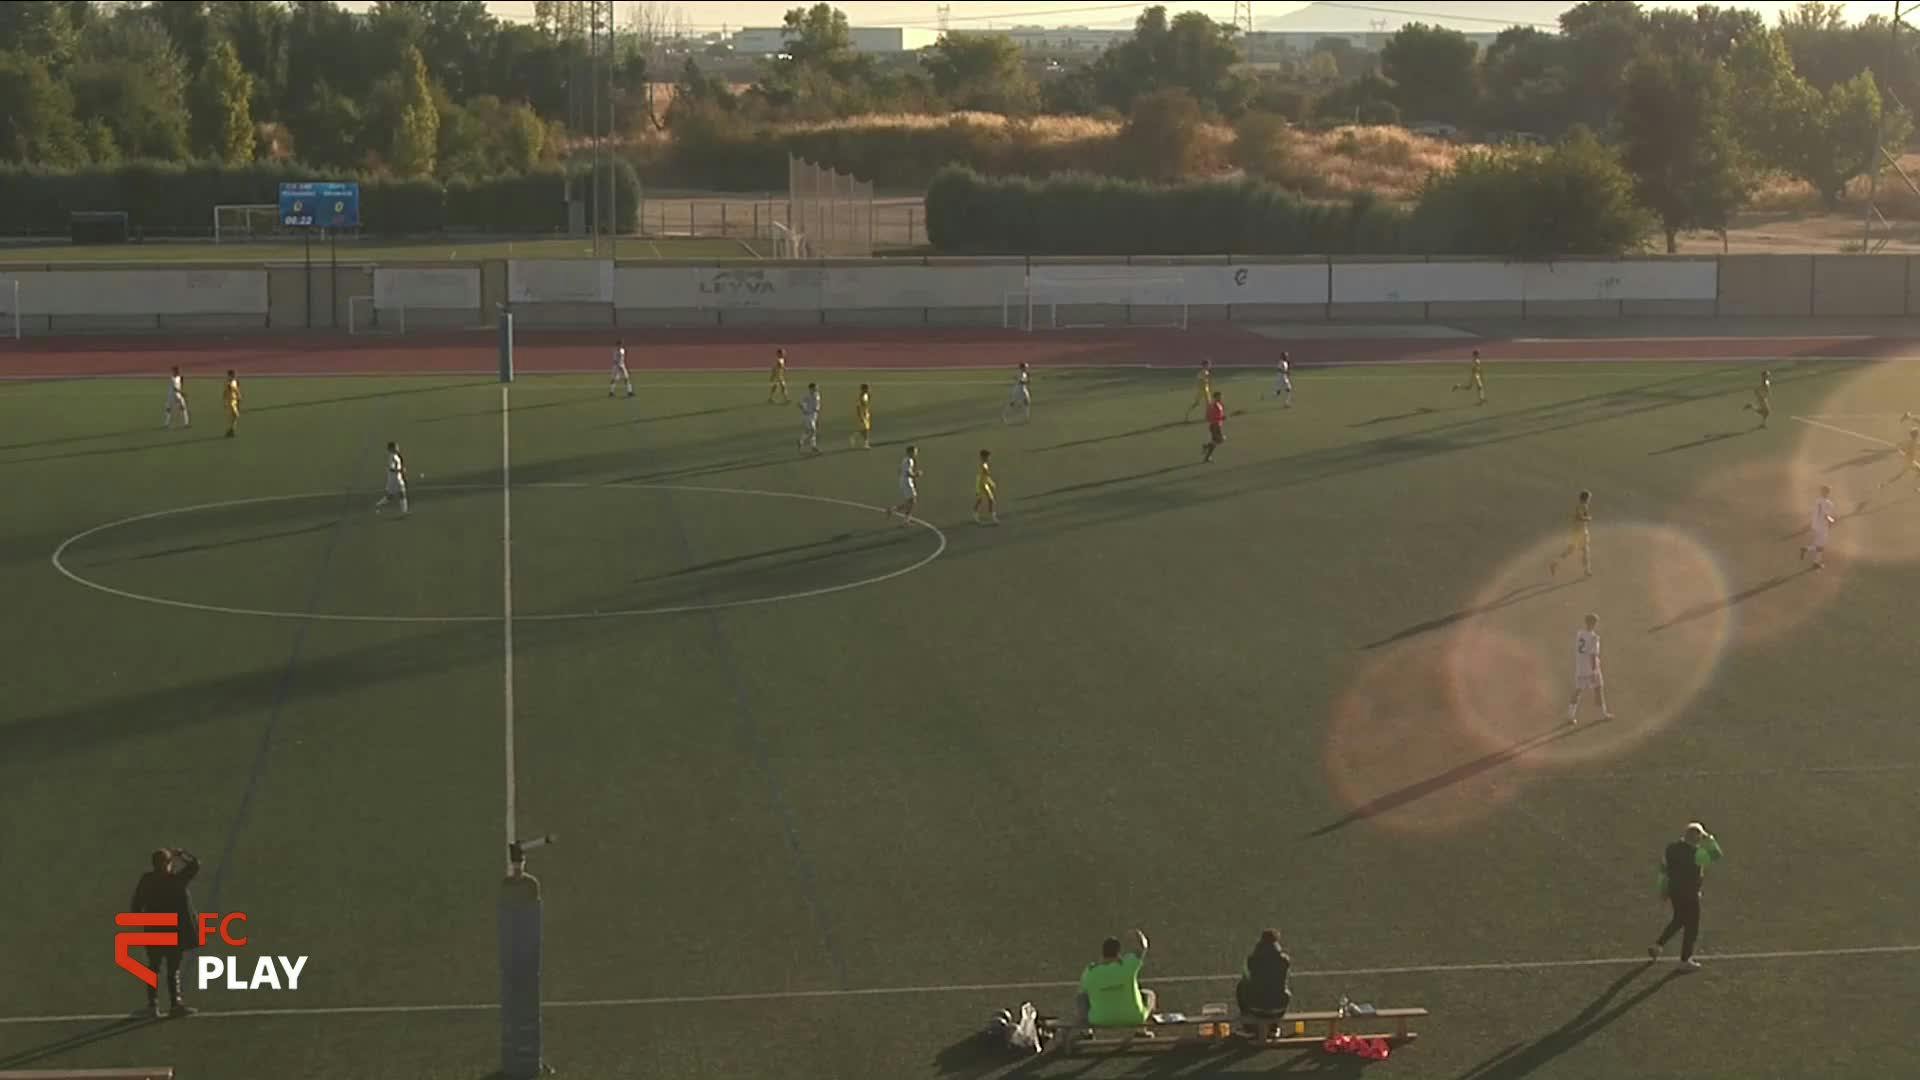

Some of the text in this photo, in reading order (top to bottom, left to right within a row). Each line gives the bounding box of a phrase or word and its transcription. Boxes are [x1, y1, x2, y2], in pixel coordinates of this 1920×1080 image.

[334, 201, 345, 213] 0
[699, 281, 776, 294] LEYVA
[1578, 637, 1586, 654] 2
